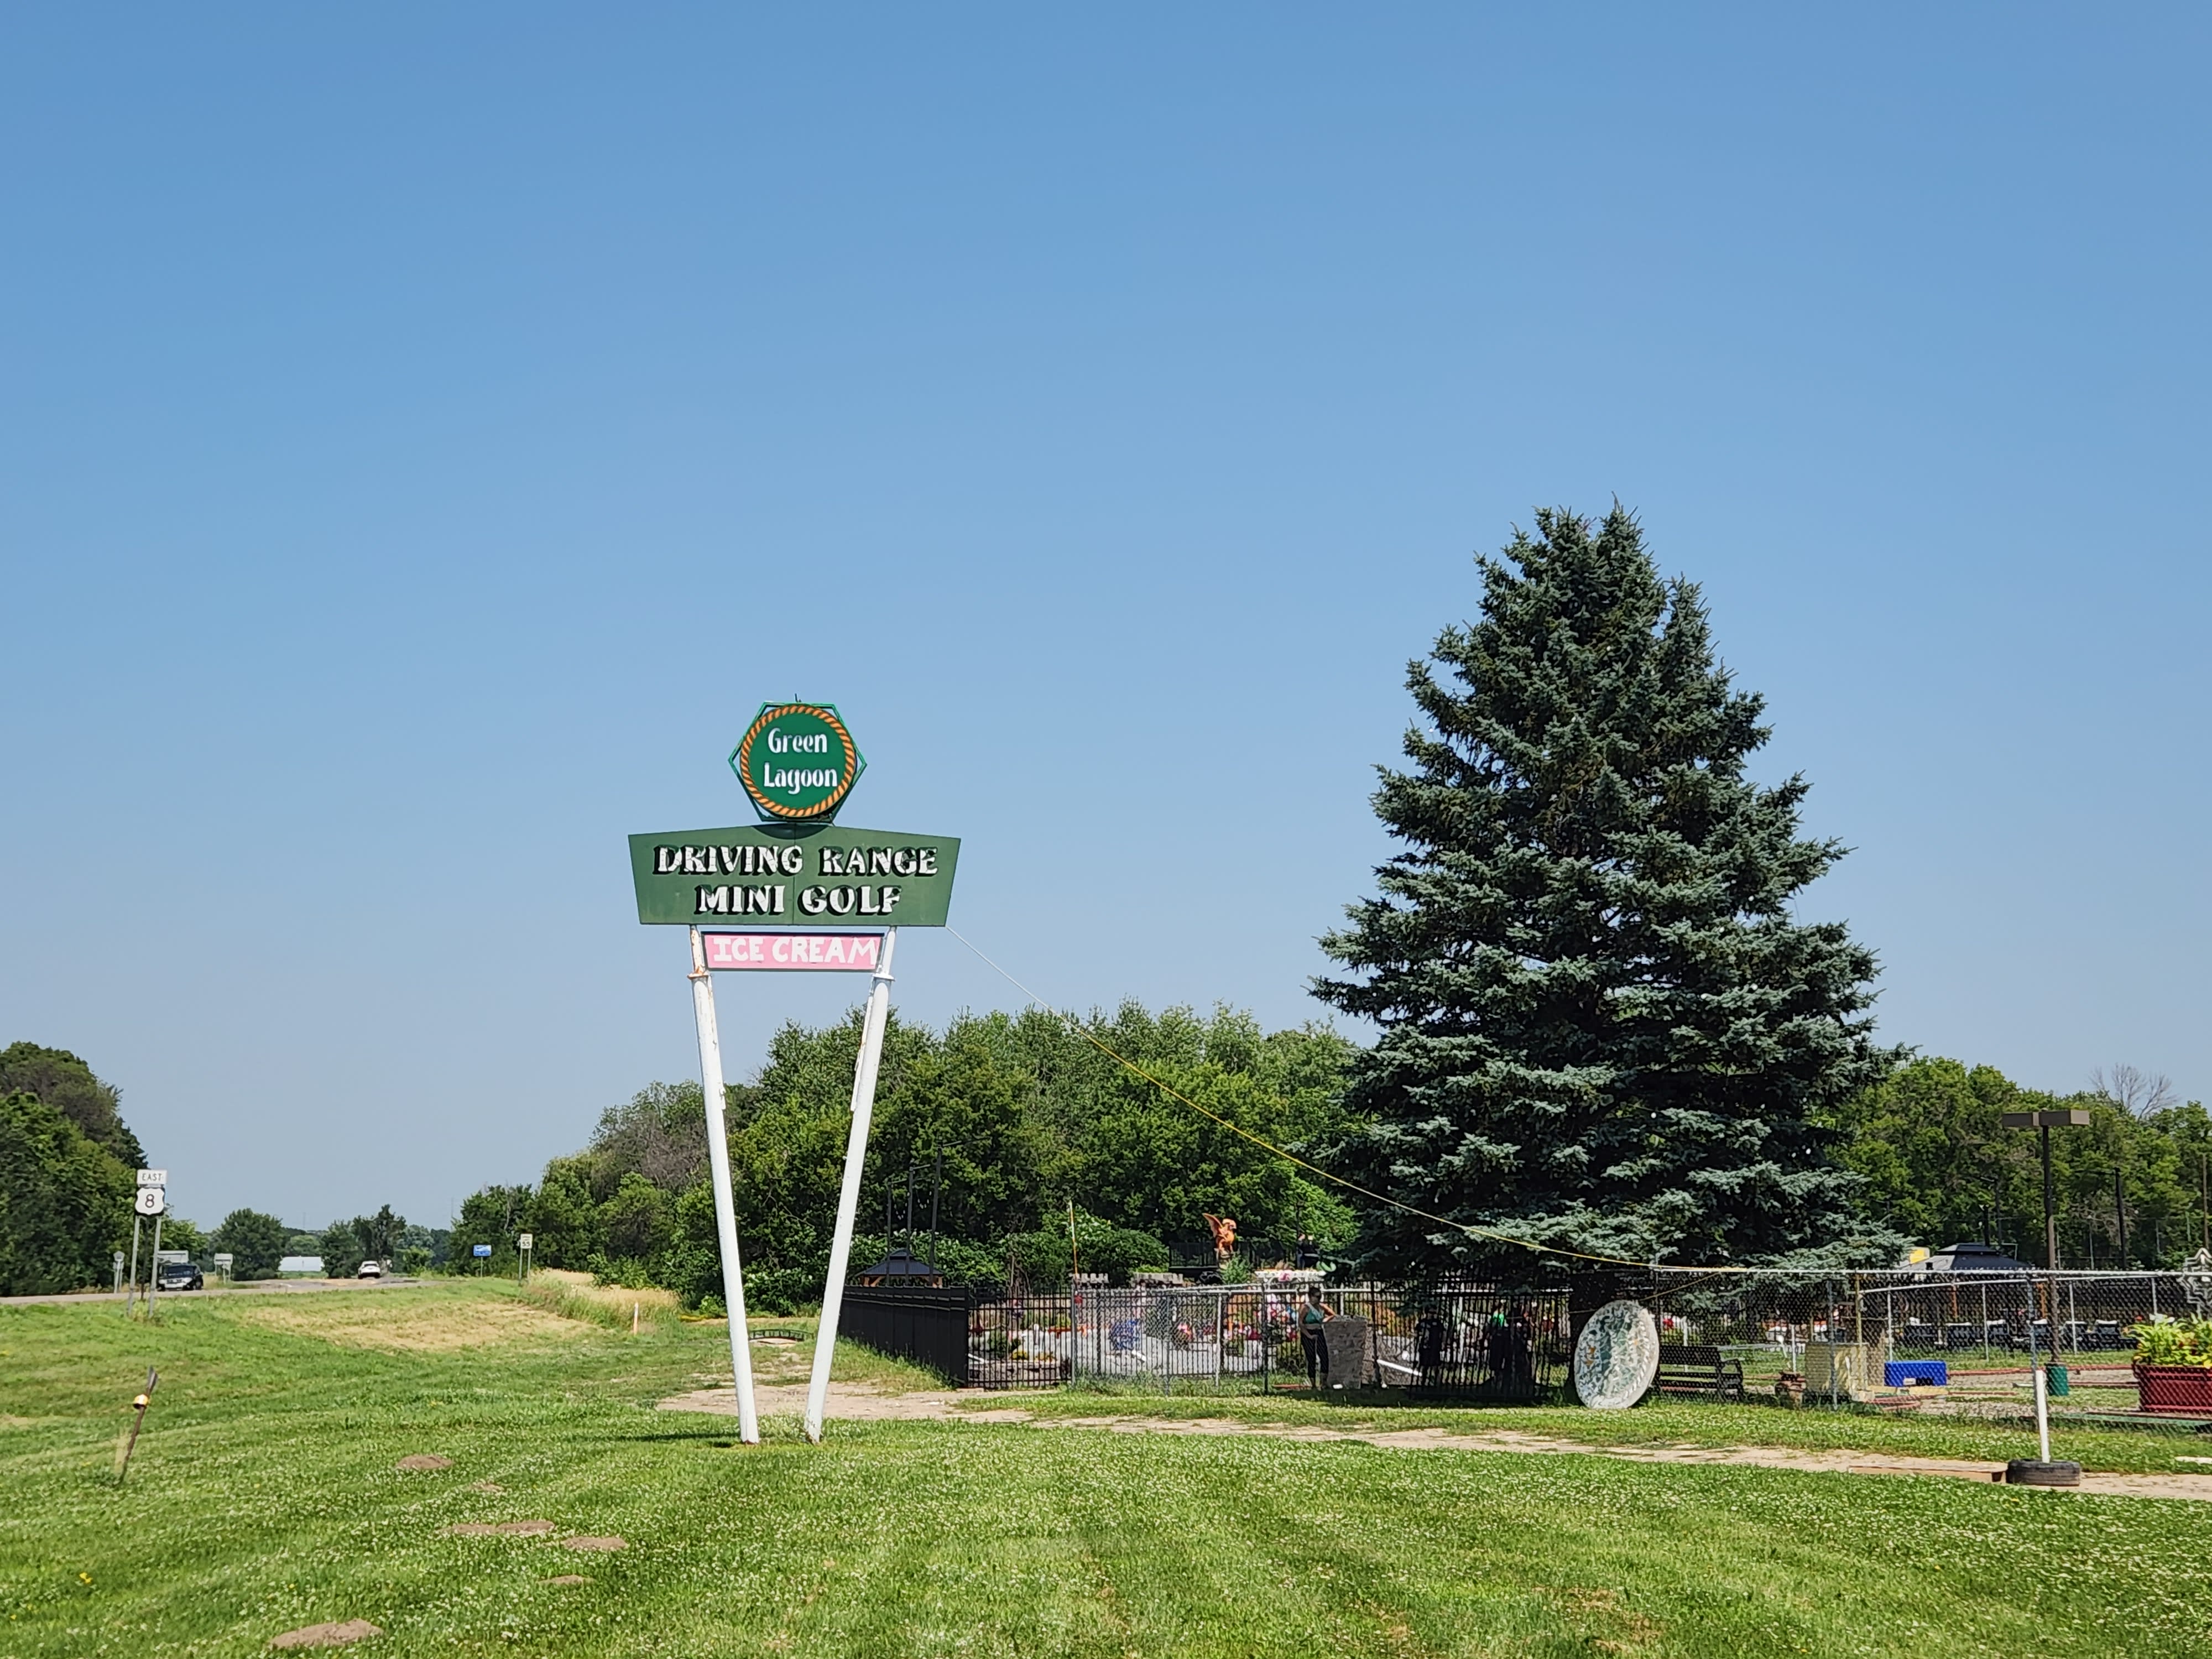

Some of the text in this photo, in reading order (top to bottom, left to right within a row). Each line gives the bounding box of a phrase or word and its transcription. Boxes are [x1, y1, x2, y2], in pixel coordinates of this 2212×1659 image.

[768, 727, 827, 753] Green
[764, 762, 838, 795] Lagoon
[654, 844, 938, 876] DRIVING RANGE
[695, 885, 902, 915] MINI GOLF
[713, 937, 878, 965] ICE CREAM
[142, 1173, 162, 1181] EAST
[145, 1193, 155, 1208] 8
